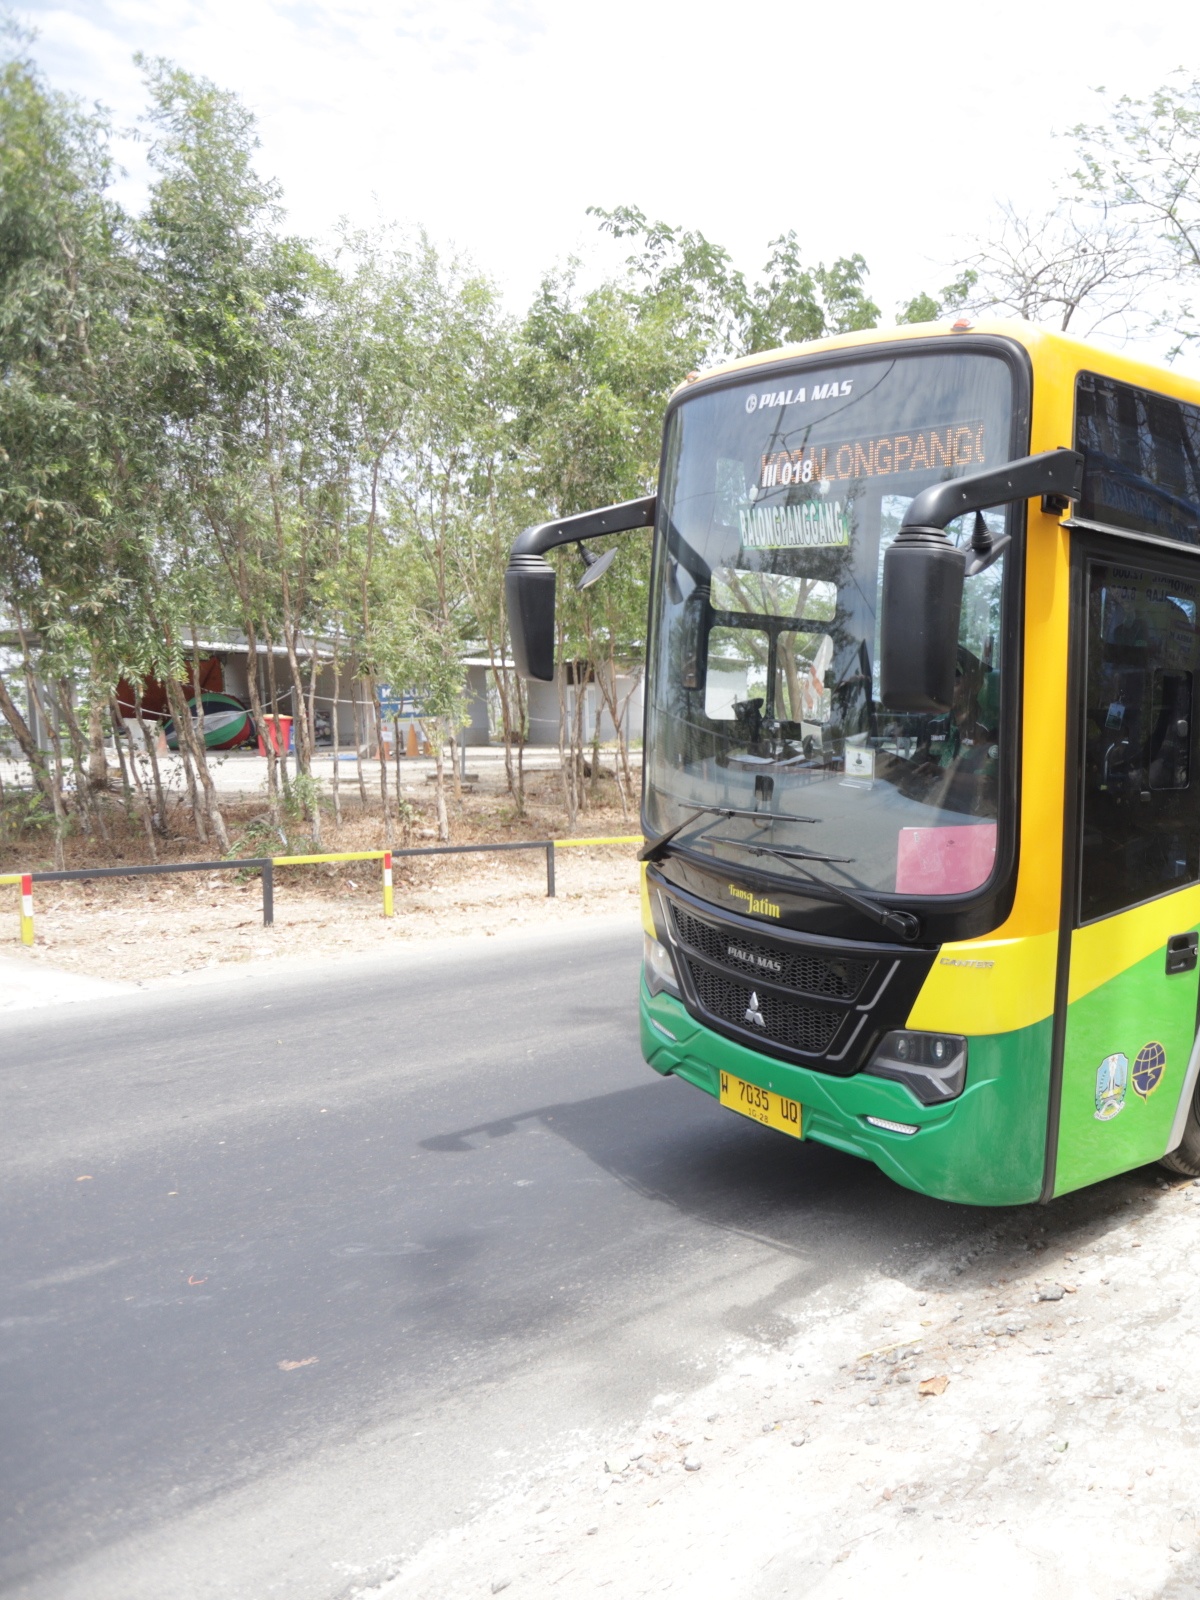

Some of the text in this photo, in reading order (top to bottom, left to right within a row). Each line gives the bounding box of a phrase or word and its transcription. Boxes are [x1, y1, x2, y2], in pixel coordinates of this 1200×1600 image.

[758, 379, 853, 409] PIALA MAS
[782, 459, 813, 486] 018
[738, 501, 844, 548] BALONGPANGGANG
[728, 884, 748, 900] Trans
[746, 893, 780, 918] Jatim
[727, 946, 781, 972] PIALA MAS
[940, 957, 995, 969] CANTER
[738, 1080, 769, 1111] 7035
